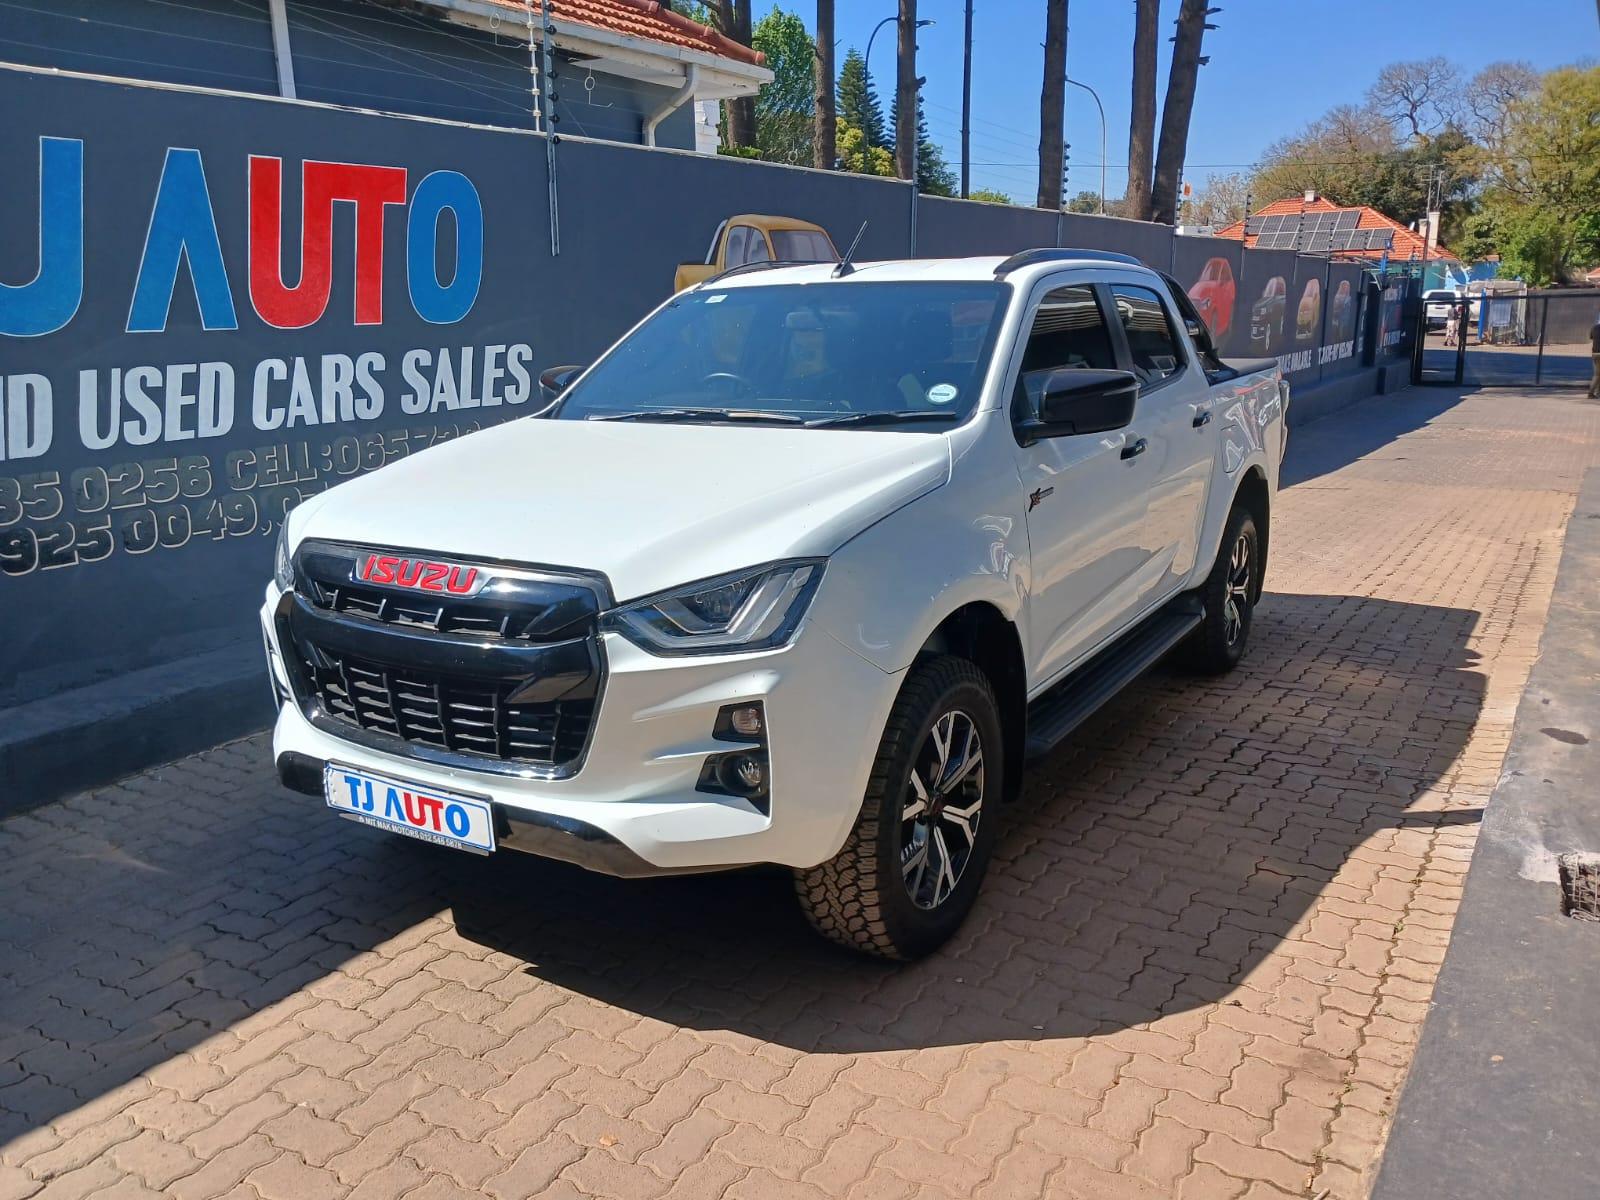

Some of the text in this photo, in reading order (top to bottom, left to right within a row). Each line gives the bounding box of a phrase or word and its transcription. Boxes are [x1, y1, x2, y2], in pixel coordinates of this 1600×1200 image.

[125, 147, 484, 333] AUTO
[79, 362, 235, 450] USED
[252, 352, 386, 430] CARS
[401, 343, 533, 415] SALES
[71, 455, 213, 515] 0256
[362, 554, 478, 594] ISUZU
[344, 775, 470, 838] TJ AUTO
